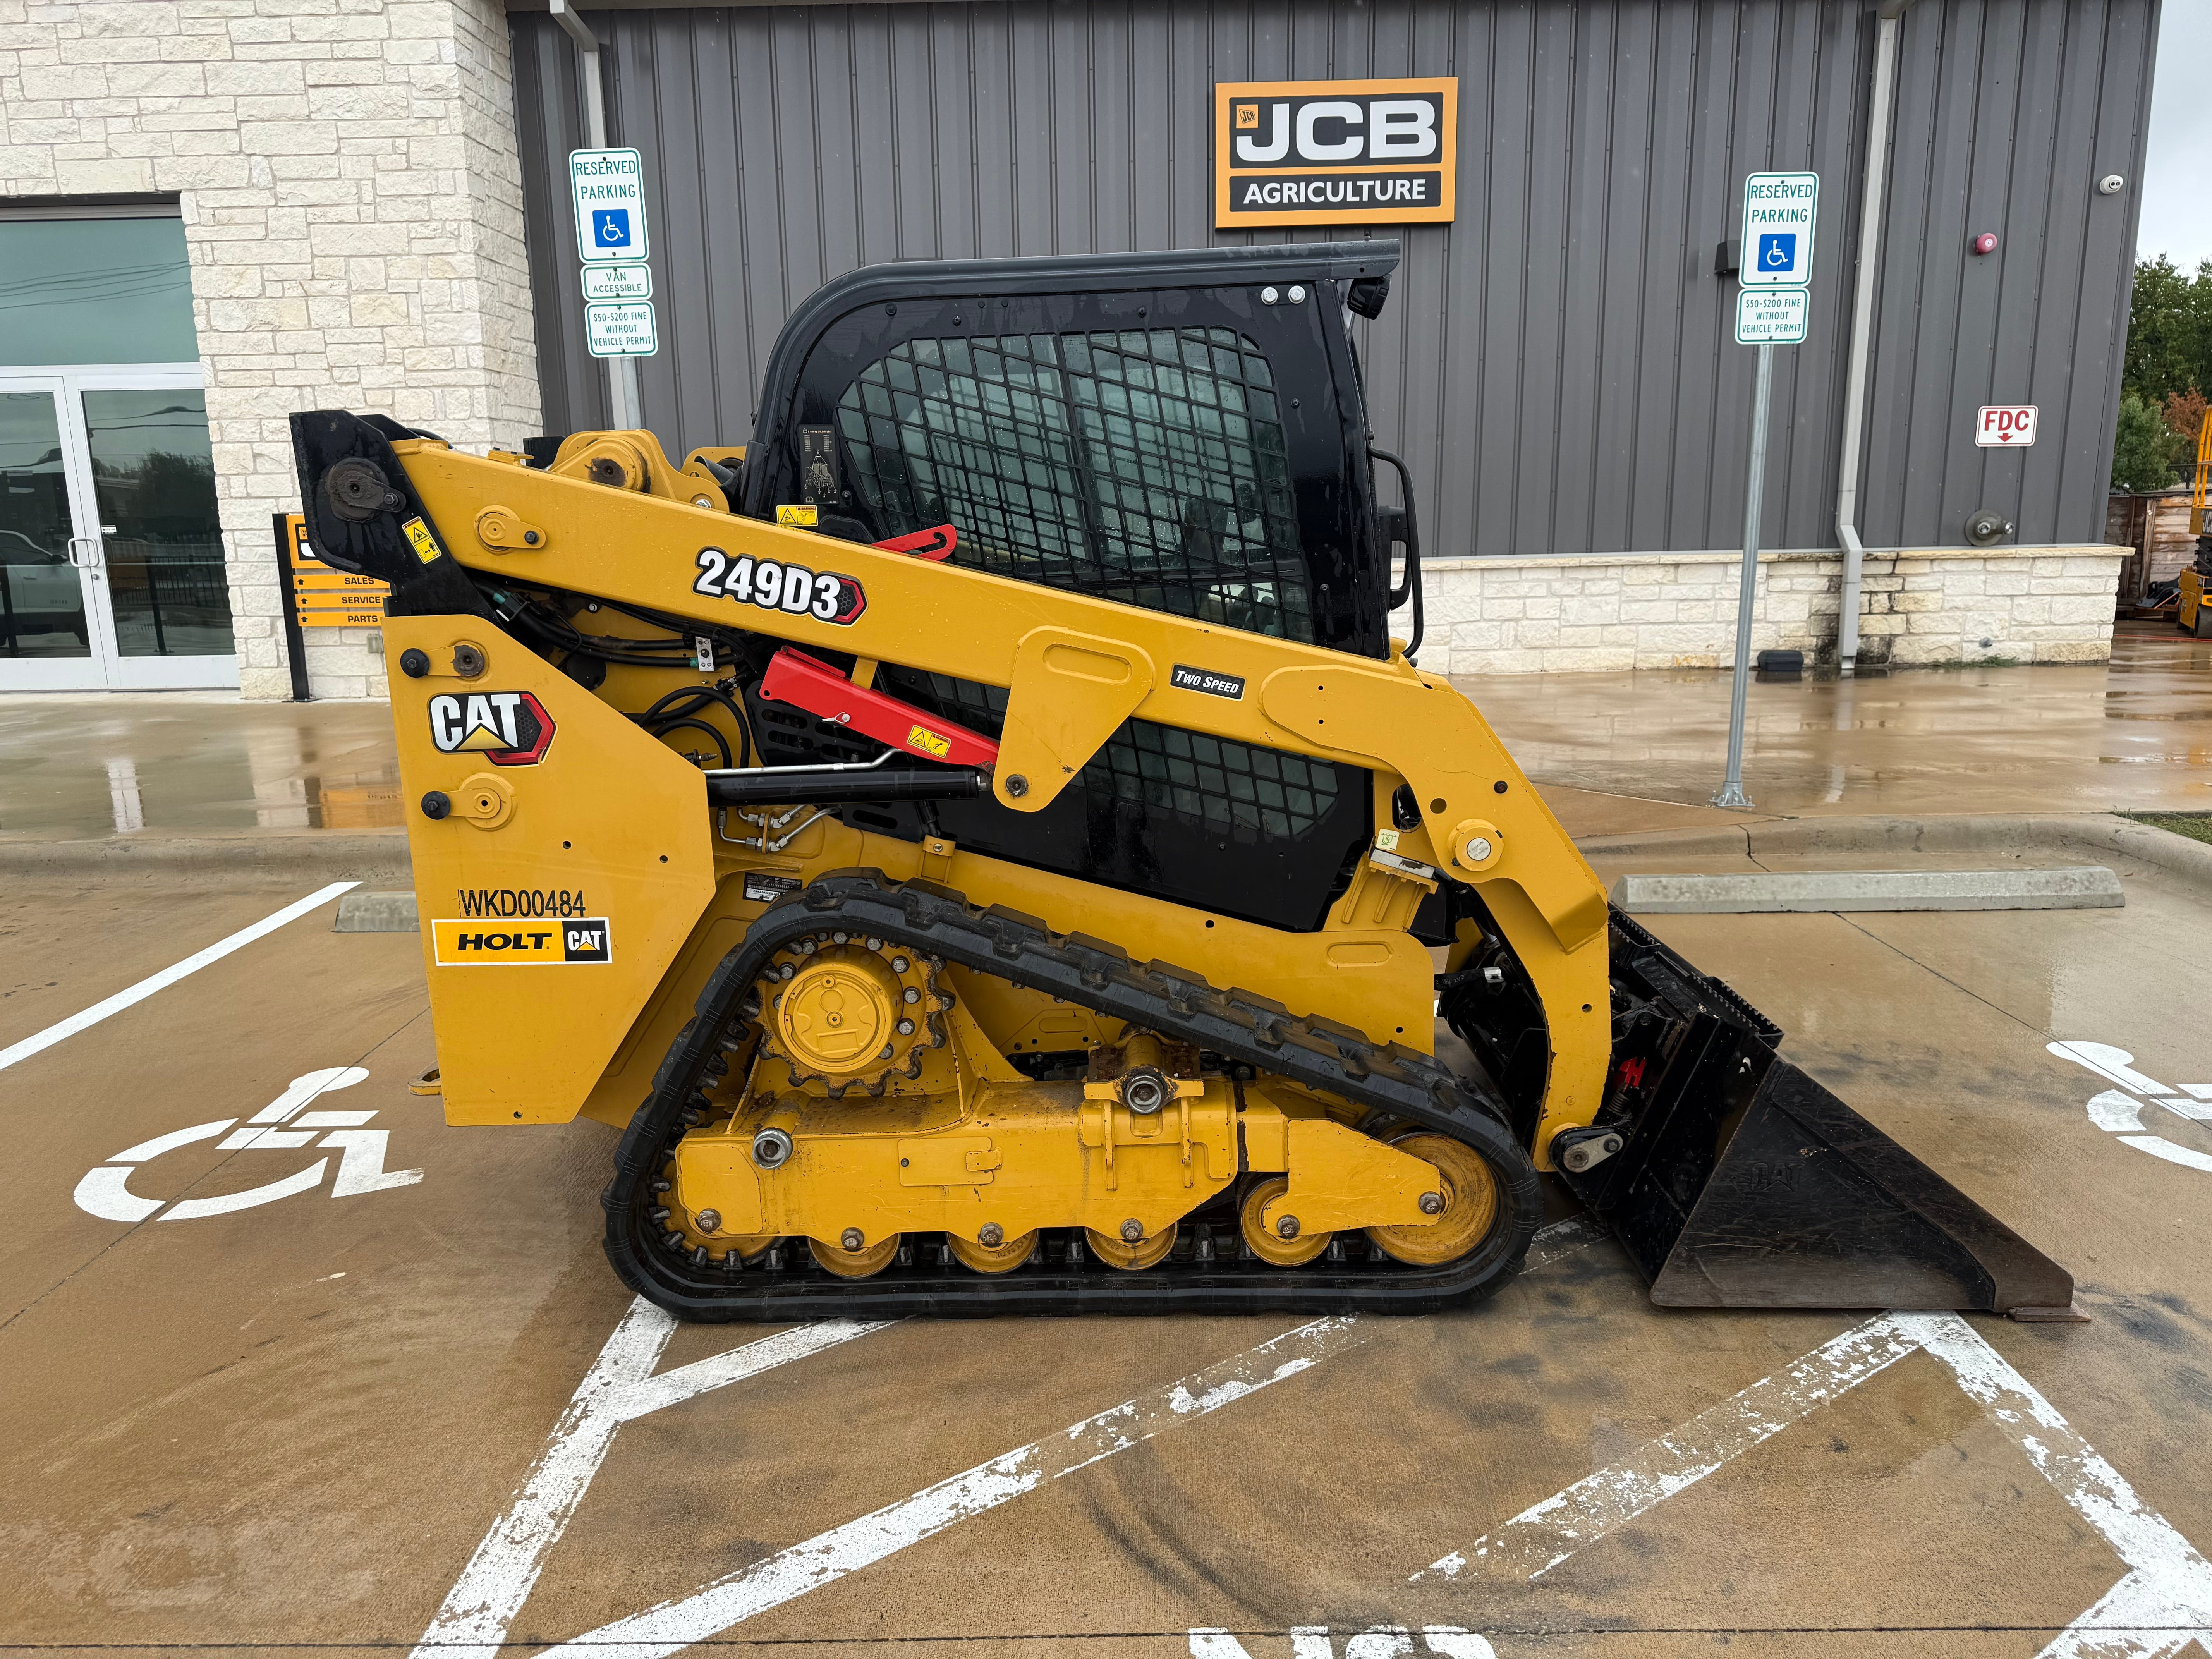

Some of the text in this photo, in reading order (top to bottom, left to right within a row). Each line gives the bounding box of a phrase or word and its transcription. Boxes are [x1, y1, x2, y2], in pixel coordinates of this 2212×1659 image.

[1242, 111, 1254, 122] JCB
[1236, 100, 1436, 161] JCB
[575, 160, 636, 176] RESERVED
[580, 184, 635, 199] PARKING
[1243, 179, 1425, 204] AGRICULTURE
[1750, 184, 1813, 199] RESERVED
[1752, 208, 1808, 223] PARKING
[606, 272, 627, 282] VAN
[593, 283, 642, 293] ACCESSIBLE
[1746, 299, 1801, 308] $50-$200 FINE
[594, 311, 647, 322] $50-$200 FINE
[1756, 311, 1789, 320] WITHOUT
[605, 324, 637, 334] WITHOUT
[1742, 323, 1801, 333] VEHICLE PERMIT
[594, 336, 651, 347] VEHICLE PERMIT
[1984, 410, 2030, 431] FDC
[2201, 509, 2212, 533] JC
[696, 550, 841, 618] 249D3
[431, 693, 521, 750] CAT
[460, 890, 586, 917] WKD00484
[458, 931, 602, 951] HOLT CAT
[1751, 1163, 1805, 1192] CAT
